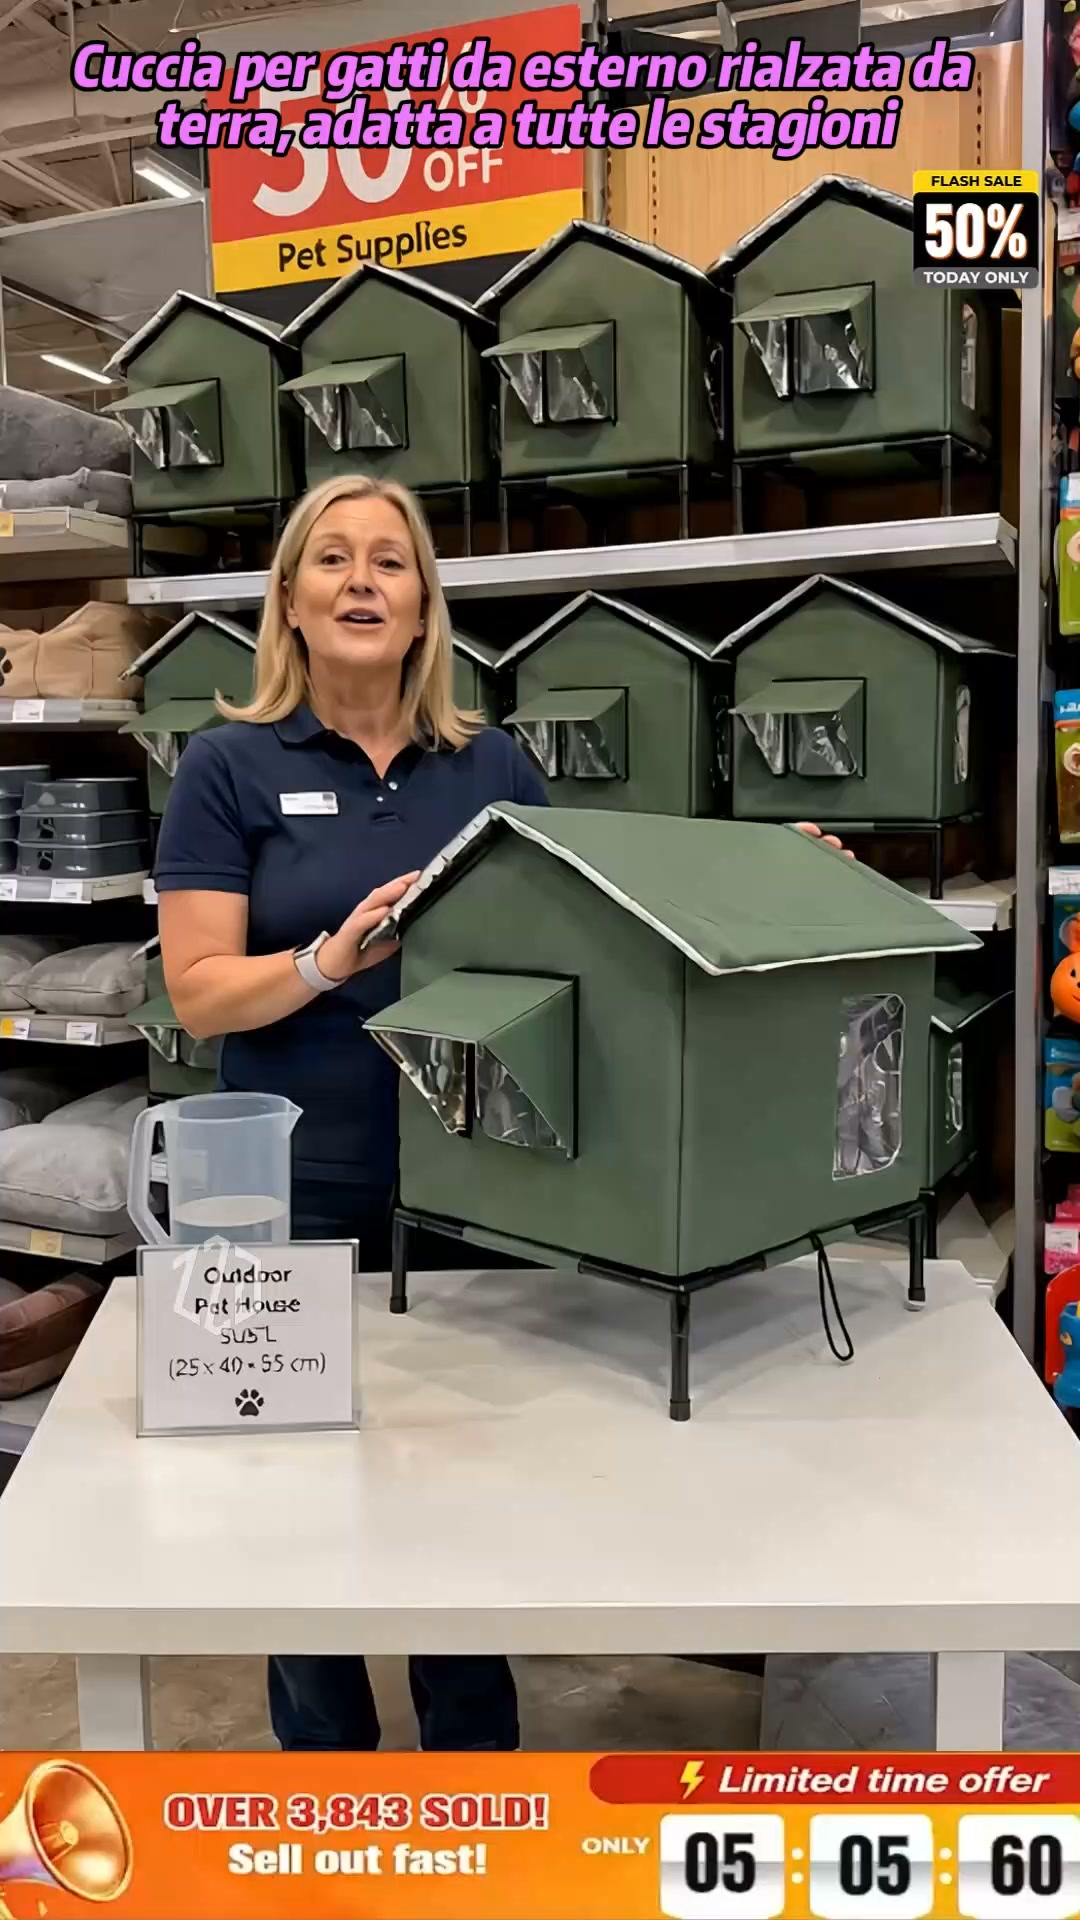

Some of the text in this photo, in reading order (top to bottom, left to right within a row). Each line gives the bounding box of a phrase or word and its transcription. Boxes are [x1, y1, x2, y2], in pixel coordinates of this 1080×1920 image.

[424, 146, 504, 192] OFF
[278, 221, 468, 272] Pet Supplies
